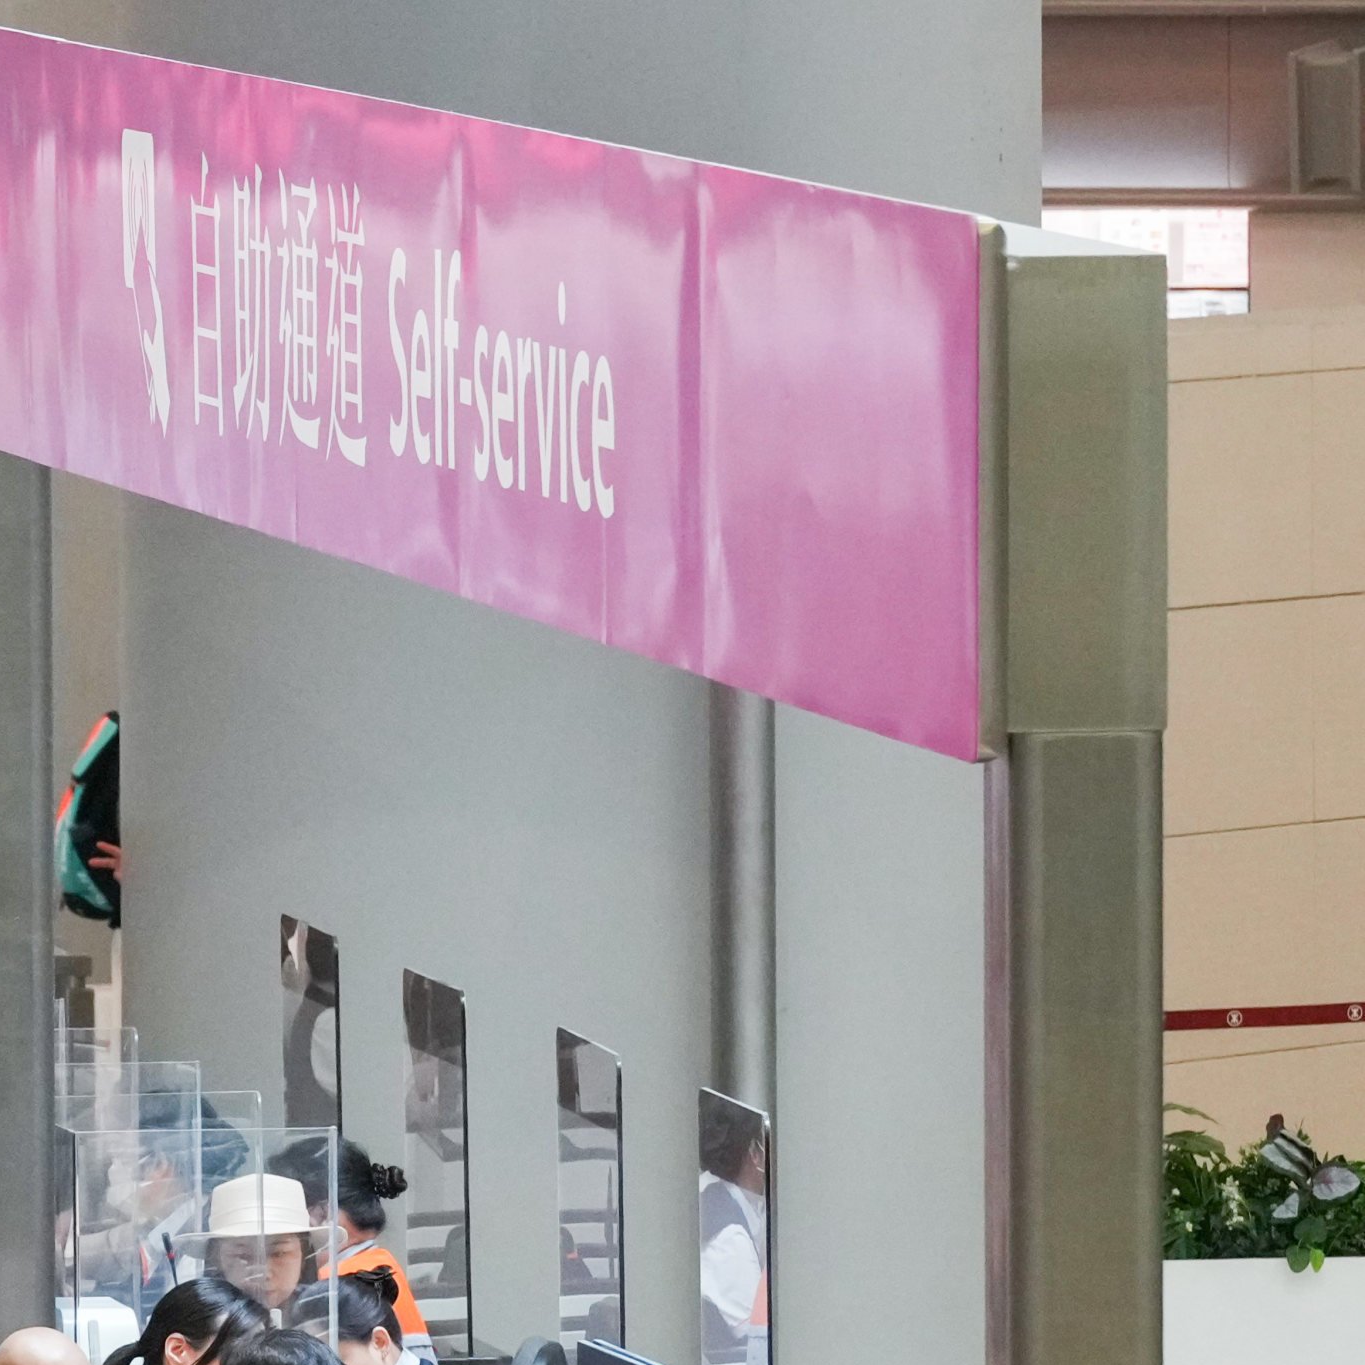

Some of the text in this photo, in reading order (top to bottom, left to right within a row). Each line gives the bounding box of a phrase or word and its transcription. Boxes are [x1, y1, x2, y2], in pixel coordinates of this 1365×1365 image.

[191, 152, 366, 467] 自助通道
[389, 247, 615, 519] Self-service
